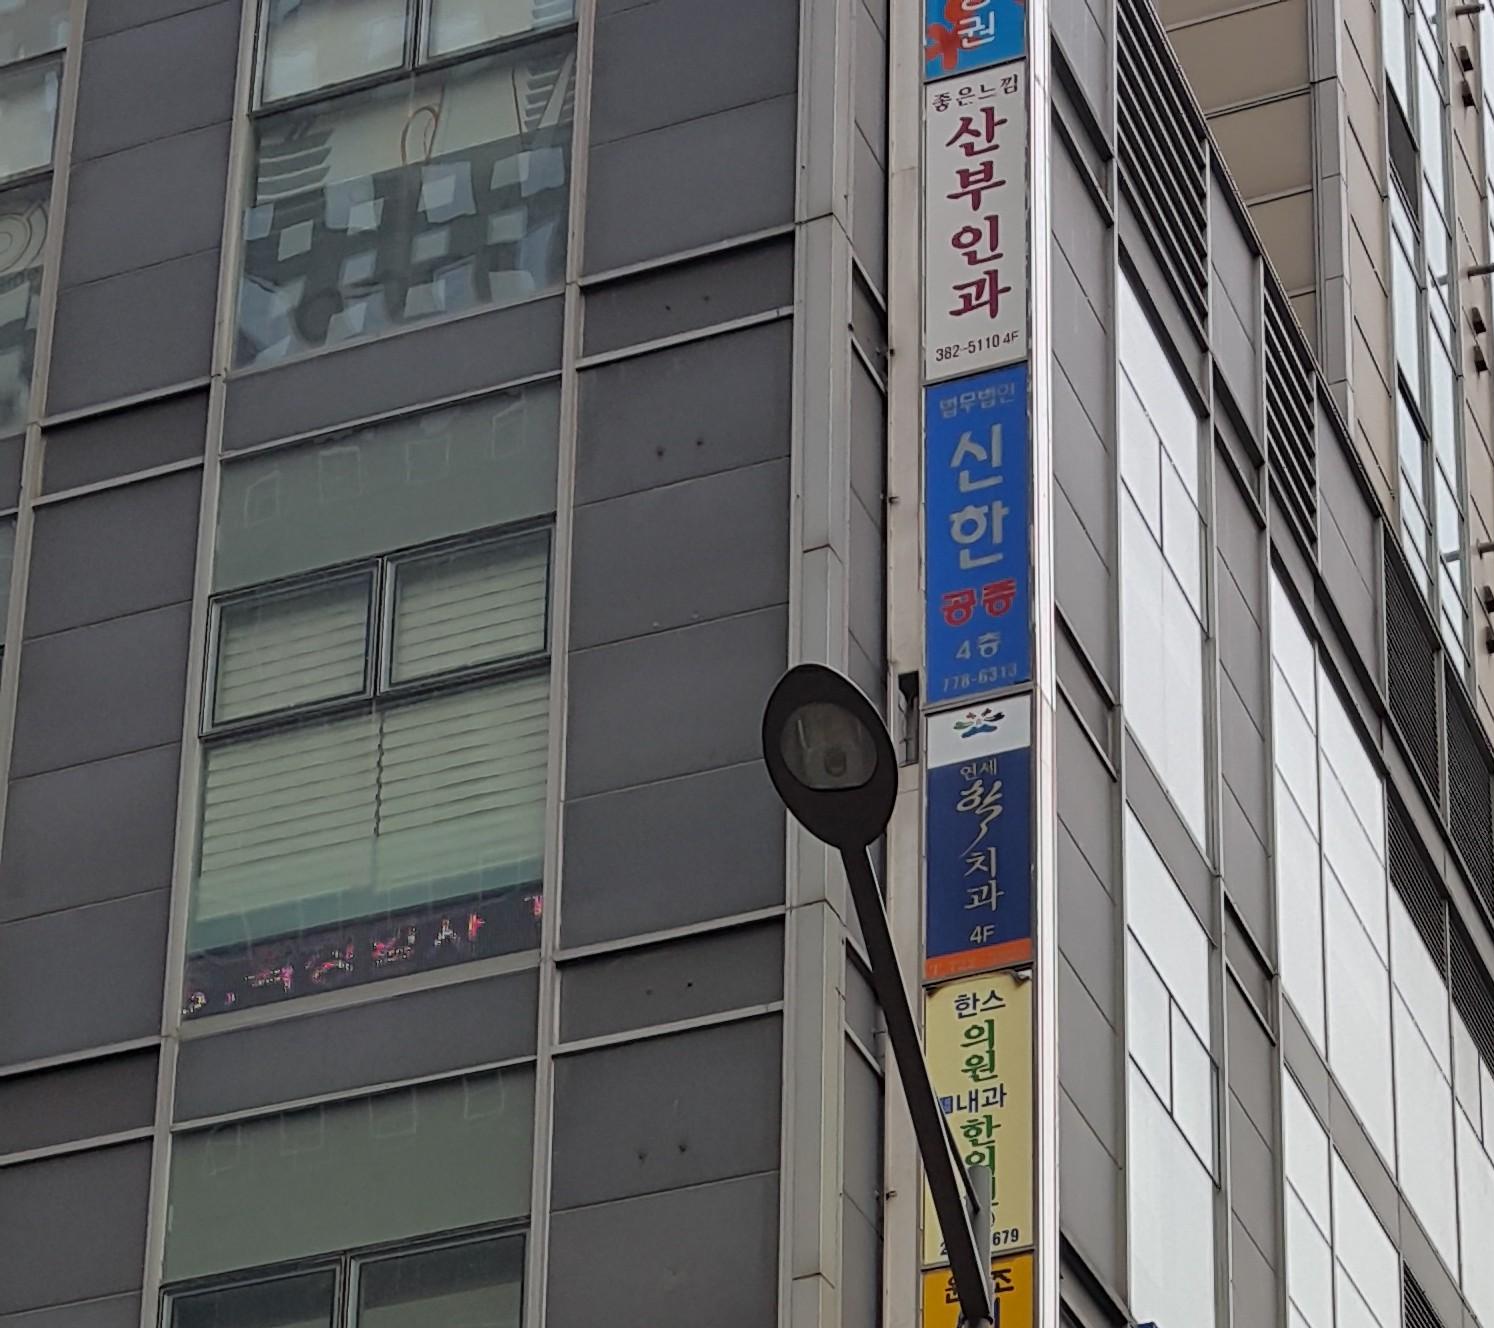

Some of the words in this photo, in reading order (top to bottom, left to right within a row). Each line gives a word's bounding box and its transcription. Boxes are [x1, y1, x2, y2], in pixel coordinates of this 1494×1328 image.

[931, 73, 1020, 113] 좋은느낌
[944, 105, 1013, 320] 산부인과
[935, 334, 1000, 361] 382-5110
[950, 423, 1009, 570] 신한
[941, 578, 1017, 628] 공증
[955, 632, 1001, 660] 4층
[959, 758, 998, 781] 연세
[969, 924, 996, 944] 4F
[954, 989, 1007, 1019] 한스
[960, 1018, 999, 1083] 의원
